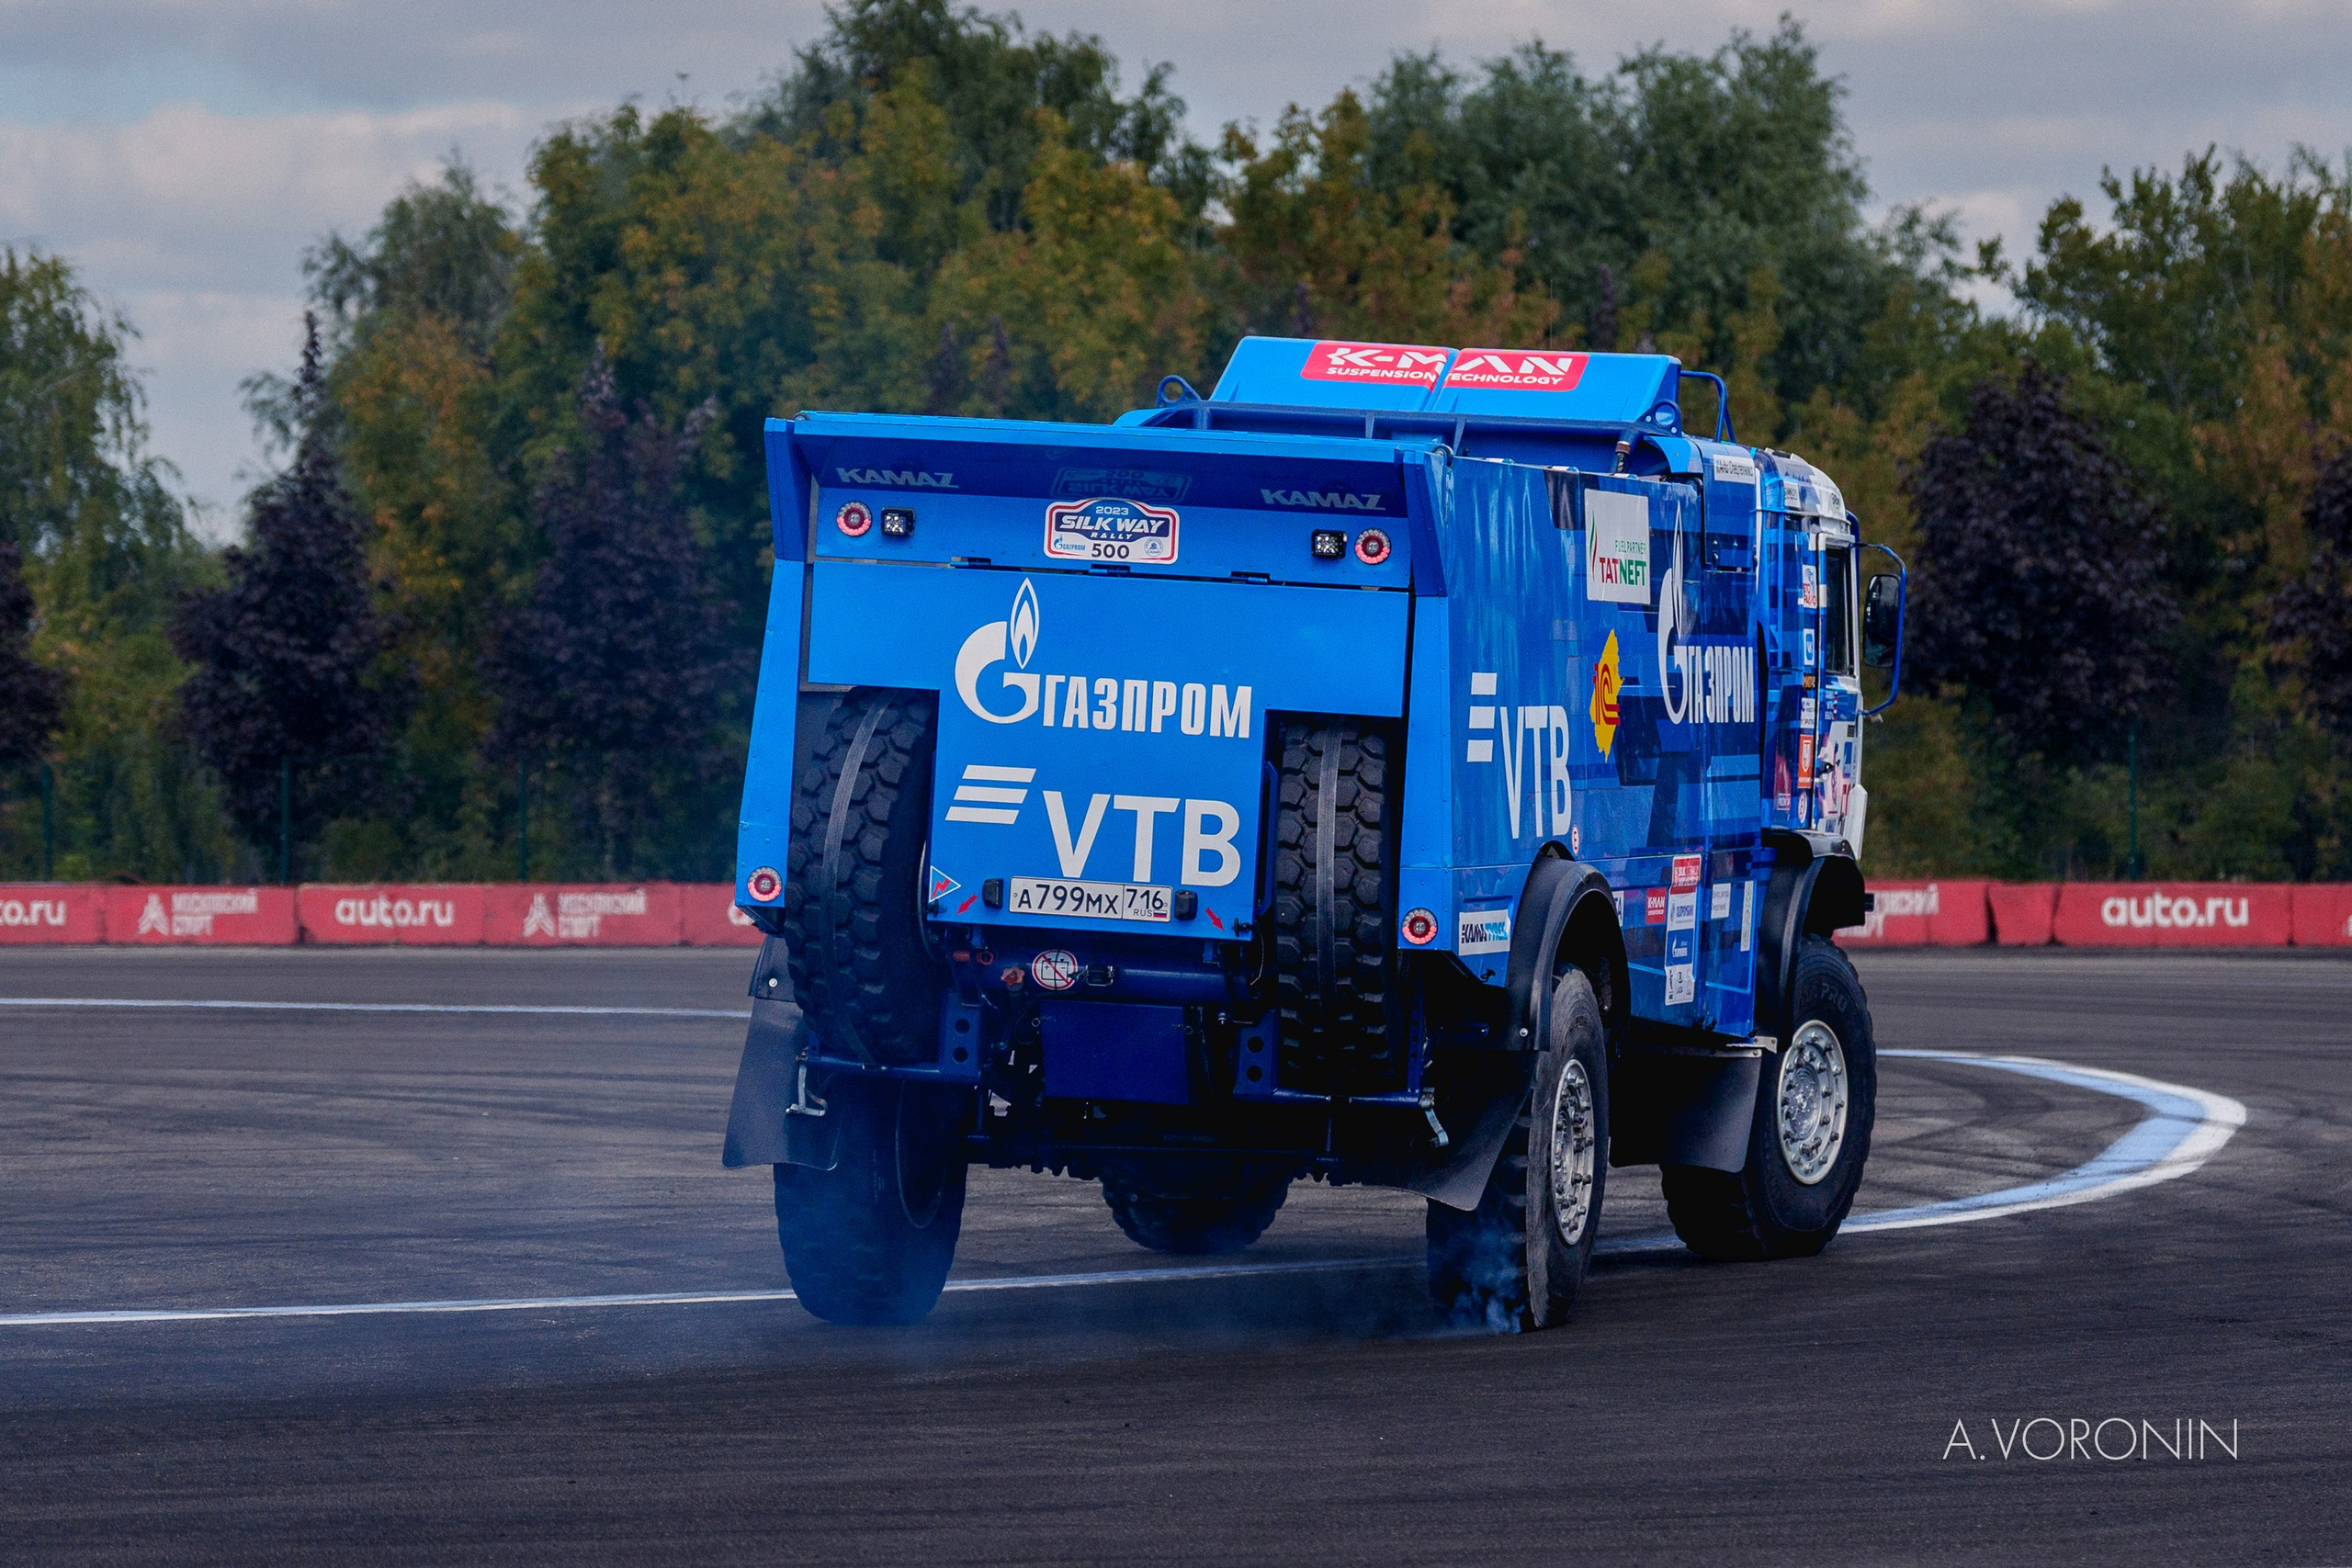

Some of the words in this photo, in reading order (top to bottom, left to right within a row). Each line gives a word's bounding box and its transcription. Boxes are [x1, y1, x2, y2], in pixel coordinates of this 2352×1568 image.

[1326, 347, 1573, 377] K-MAN
[1326, 367, 1437, 382] SUSPENSION
[835, 468, 960, 489] KAMAZ
[1095, 505, 1129, 515] 2023
[1260, 489, 1386, 511] KAMAZ
[1059, 514, 1114, 531] SILK
[1116, 518, 1165, 534] WAY
[1090, 532, 1133, 540] RALLY
[1091, 543, 1130, 559] 500
[1600, 557, 1646, 586] TATNEFT
[1688, 645, 1755, 724] ГАЗПРОМ
[1043, 674, 1251, 739] ГАЗПРОМ
[1499, 705, 1572, 840] VTB
[1042, 790, 1241, 887] VTB
[1125, 888, 1164, 909] 716
[0, 899, 67, 927] o.ru
[334, 894, 455, 929] auto.ru
[1133, 908, 1153, 918] RUS
[2101, 892, 2249, 928] auto.ru
[1461, 923, 1487, 944] KAMA
